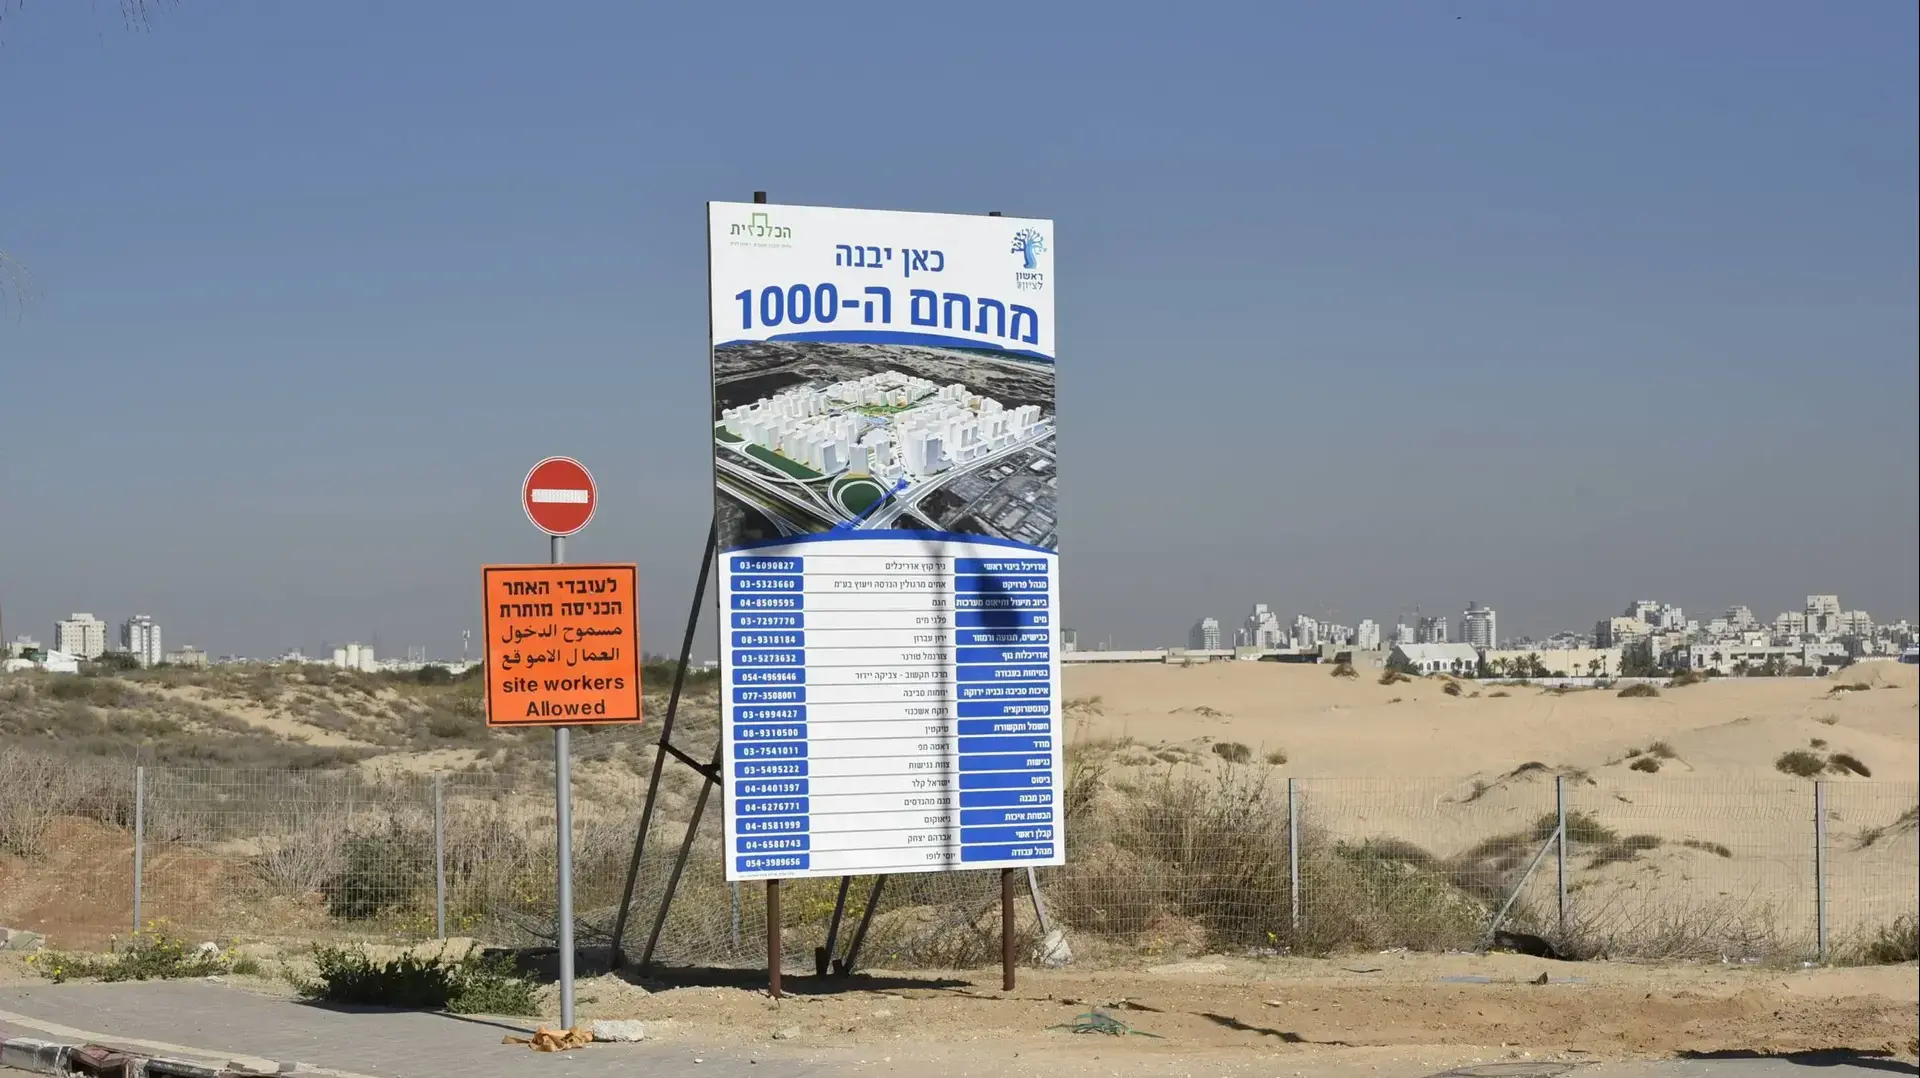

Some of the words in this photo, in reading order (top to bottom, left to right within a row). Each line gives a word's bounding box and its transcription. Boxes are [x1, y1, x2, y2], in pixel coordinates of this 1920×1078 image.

[836, 244, 892, 268] יבנה
[902, 249, 944, 278] כאן
[1016, 272, 1043, 281] ראשון
[735, 283, 891, 329] ה-1000
[910, 289, 1038, 346] מתחם
[740, 561, 794, 570] 03-6090827
[885, 560, 919, 570] אדריכלים
[921, 562, 933, 572] קוץ
[1021, 561, 1046, 570] אדריכל
[503, 580, 550, 595] האתר
[557, 577, 617, 594] לעובדי
[740, 580, 794, 588] 03-5323660
[854, 581, 872, 590] ויעוץ
[1002, 581, 1027, 590] פרויקט
[1028, 580, 1046, 588] מנהל
[740, 599, 794, 607] 04-8509595
[1011, 597, 1031, 606] תיעול
[500, 602, 553, 618] מותרת
[561, 601, 622, 616] הכניסה
[741, 617, 795, 625] 03-7297770
[931, 615, 947, 624] פלגי
[502, 624, 557, 644] الدخول
[563, 626, 623, 642] مسموح
[741, 636, 796, 644] 08-9318184
[742, 654, 796, 662] 03-5273632
[1002, 652, 1013, 661] נוף
[1015, 650, 1048, 659] אדריכלות
[742, 673, 796, 681] 054-4969646
[875, 672, 897, 681] צביקה
[905, 672, 929, 680] תקשוב
[1023, 669, 1048, 677] בטיחות
[503, 677, 538, 693] site
[544, 675, 624, 691] workers
[743, 691, 796, 700] 077-3508001
[964, 689, 984, 697] ירוקה
[526, 699, 606, 717] Allowed
[1003, 705, 1048, 715] קונסטרוקציה
[743, 710, 797, 719] 03-6994427
[994, 723, 1025, 732] ותקשורת
[1027, 721, 1048, 730] חשמל
[743, 728, 798, 737] 08-9310500
[744, 747, 799, 755] 03-7541011
[744, 765, 799, 774] 03-5495222
[912, 779, 925, 789] קלר
[927, 778, 950, 786] ישראל
[745, 784, 800, 793] 04-8401397
[904, 798, 935, 806] מהנדסים
[745, 802, 800, 812] 04-6276771
[1027, 812, 1051, 820] הבטחת
[745, 821, 800, 830] 04-8581999
[928, 834, 951, 842] אברהם
[1036, 829, 1051, 839] קבלן
[746, 839, 801, 849] 04-6588743
[907, 835, 925, 844] יצחק
[1012, 848, 1033, 856] עבודה
[1034, 846, 1052, 855] מנהל
[746, 858, 800, 867] 054-3989656
